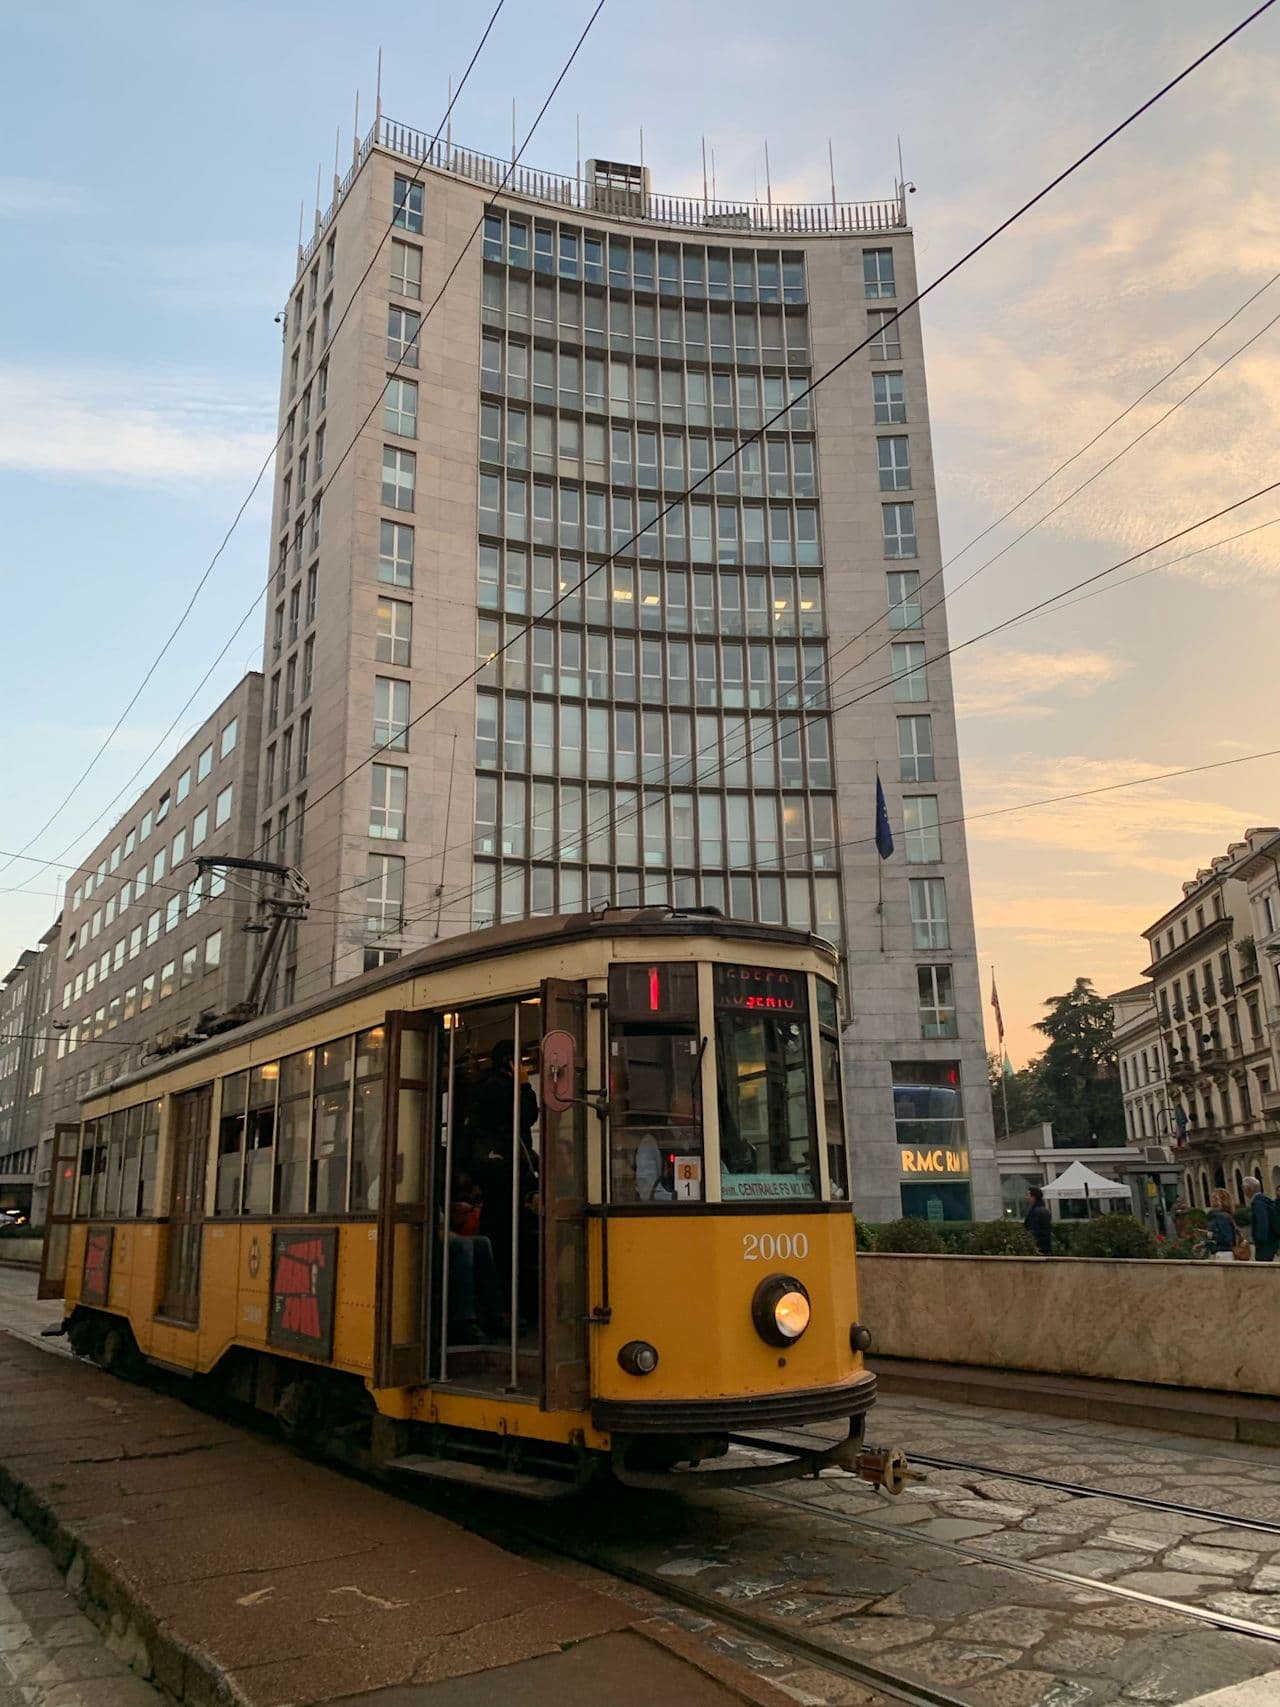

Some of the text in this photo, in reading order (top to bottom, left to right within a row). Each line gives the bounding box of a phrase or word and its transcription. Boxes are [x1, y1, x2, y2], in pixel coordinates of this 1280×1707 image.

[649, 966, 658, 1010] 1
[901, 1150, 944, 1172] RMC
[684, 1165, 691, 1179] 8
[684, 1182, 690, 1196] 1
[738, 1183, 777, 1196] CENTRALE
[778, 1183, 790, 1196] FS
[743, 1232, 808, 1260] 2000
